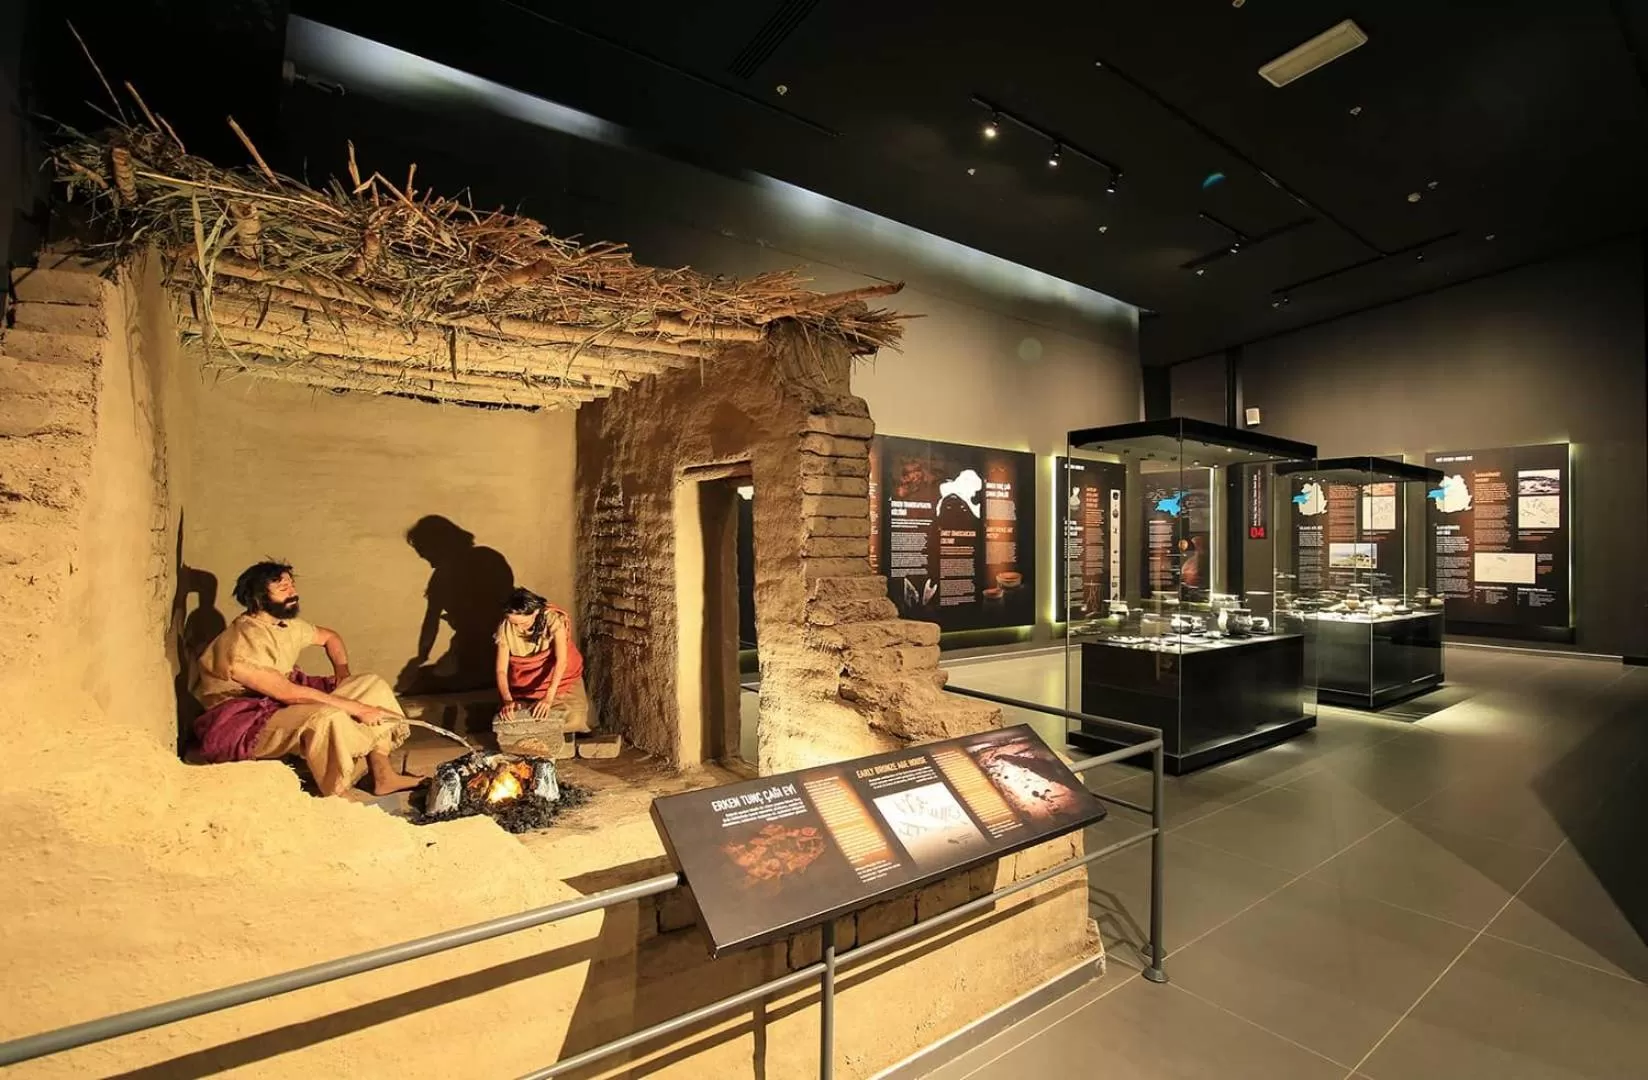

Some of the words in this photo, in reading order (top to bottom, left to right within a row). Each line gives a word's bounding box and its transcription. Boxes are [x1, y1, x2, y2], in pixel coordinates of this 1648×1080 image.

[1250, 527, 1264, 537] 04
[711, 796, 741, 812] ERKEN
[740, 791, 764, 805] TUNÇ
[763, 786, 784, 803] ÇAĞI
